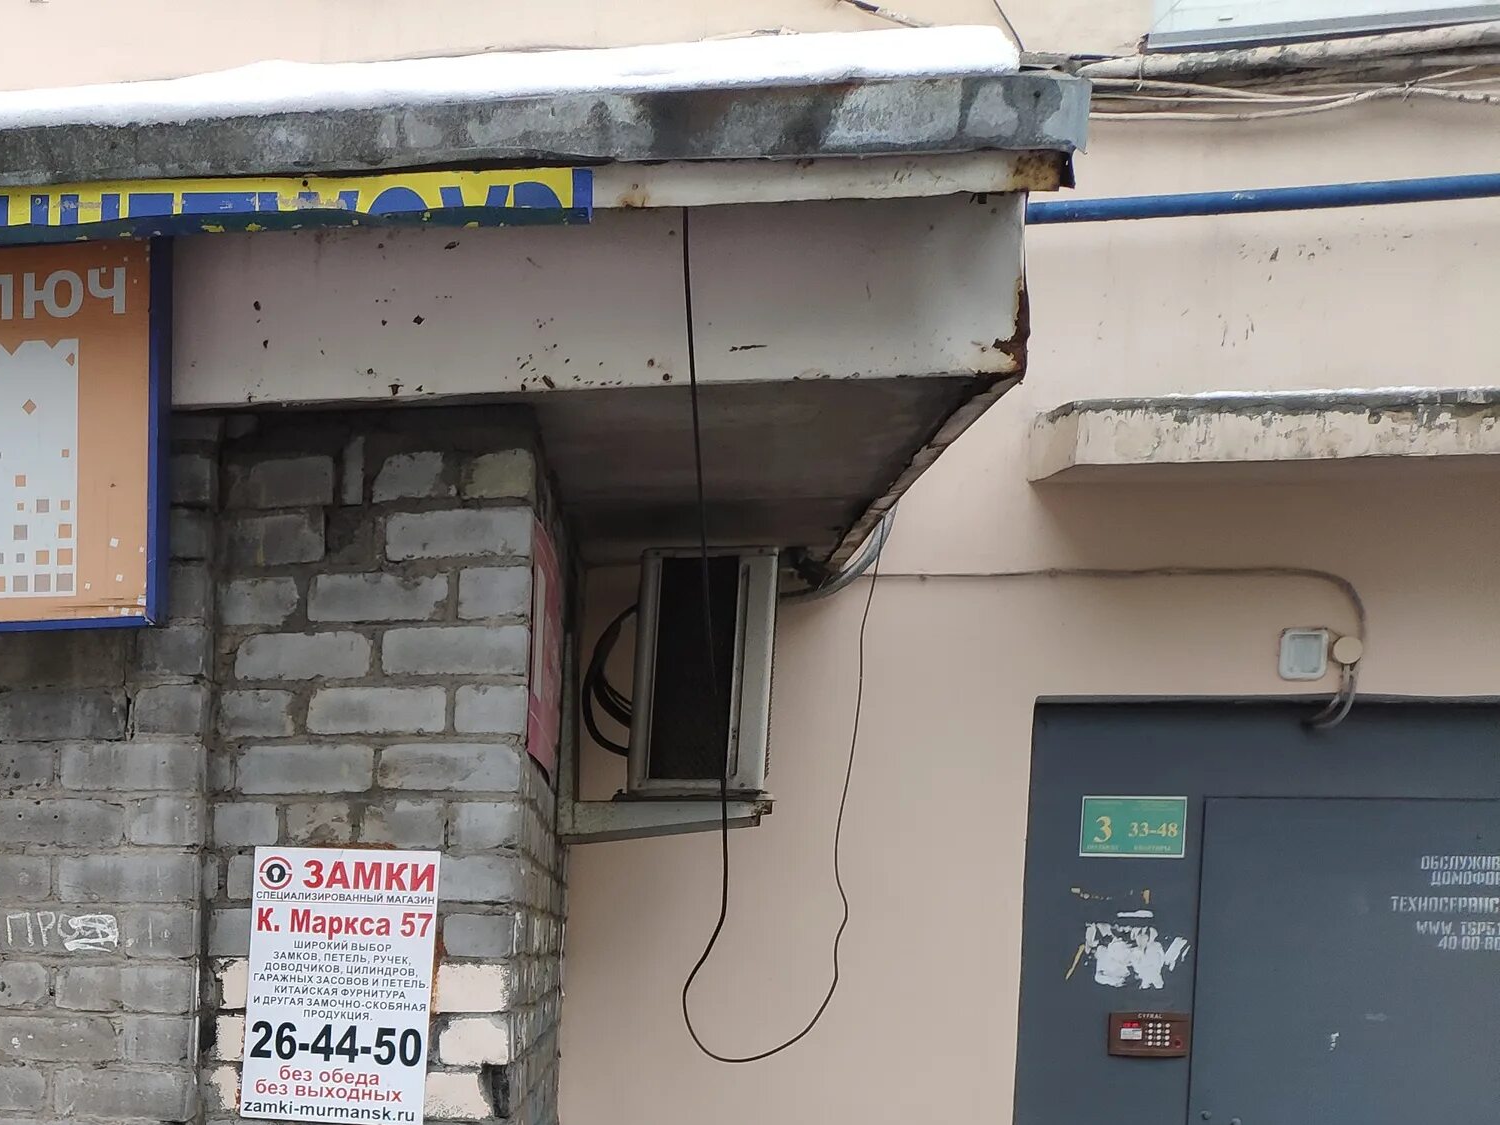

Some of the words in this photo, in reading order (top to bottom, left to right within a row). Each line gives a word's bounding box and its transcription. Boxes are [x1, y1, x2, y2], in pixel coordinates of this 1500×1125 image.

[1093, 815, 1112, 843] 3
[1128, 822, 1178, 837] 33-48
[302, 859, 436, 892] ЗАМКИ
[256, 890, 383, 904] СПЕЦИАЛИЗИРОВАННЫЙ
[386, 894, 435, 905] МАГАЗИН
[256, 907, 280, 932] К.
[290, 908, 391, 940] Маркса
[400, 912, 433, 938] 57
[293, 940, 348, 951] ШИРОКИЙ
[351, 943, 392, 953] ВЫБОР
[273, 951, 321, 962] ЗАМКОВ,
[323, 953, 371, 964] ПЕТЕЛЬ,
[373, 955, 411, 966] РУЧЕК,
[264, 962, 343, 974] ДОВОДЧИКОВ,
[346, 966, 418, 978] ЦИЛИНДРОВ,
[253, 973, 314, 984] ГАРАЖНЫХ
[316, 976, 369, 986] ЗАСОВОВ
[372, 978, 379, 987] И
[382, 979, 429, 989] ПЕТЕЛЬ.
[274, 984, 338, 996] КИТАЙСКАЯ
[341, 989, 406, 999] ФУРНИТУРА
[253, 996, 260, 1004] И
[263, 996, 304, 1006] ДРУГАЯ
[306, 998, 426, 1012] ЗАМОЧНО-СКОБЯНАЯ
[303, 1009, 373, 1021] ПРОДУКЦИЯ.
[250, 1020, 422, 1067] 26-44-50
[279, 1065, 313, 1081] без
[319, 1068, 380, 1086] обеда
[255, 1079, 288, 1095] без
[295, 1084, 402, 1102] выходных
[243, 1099, 415, 1122] zamki-murmansk.ru
